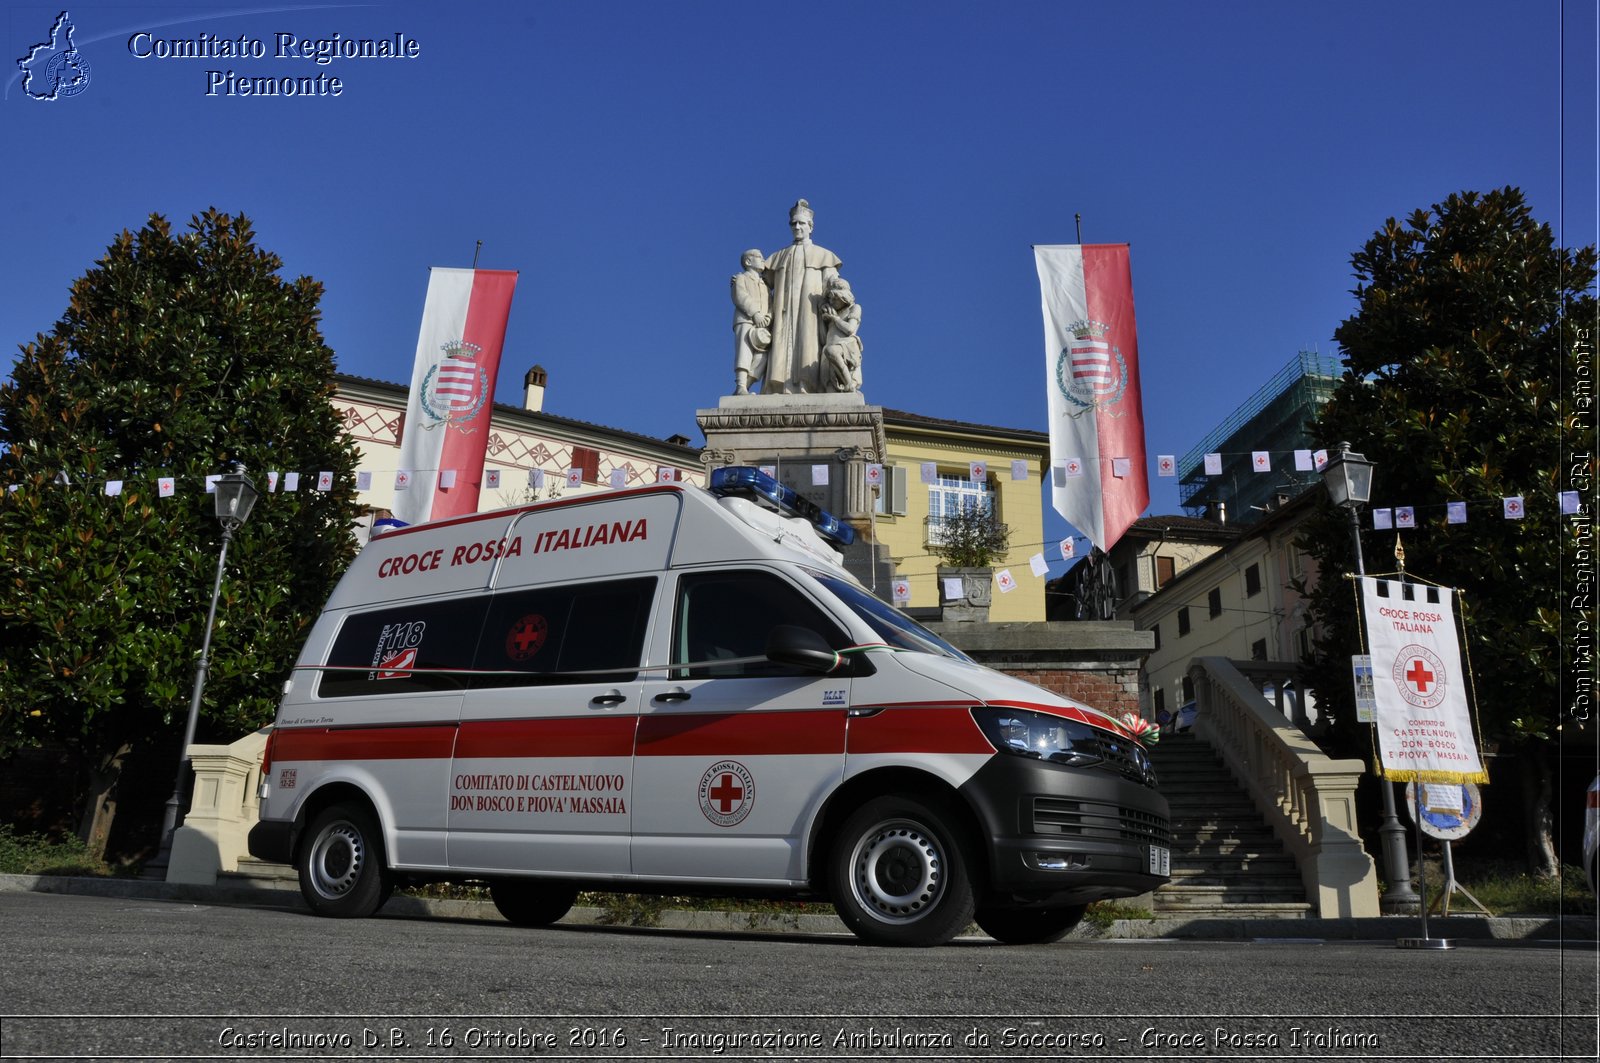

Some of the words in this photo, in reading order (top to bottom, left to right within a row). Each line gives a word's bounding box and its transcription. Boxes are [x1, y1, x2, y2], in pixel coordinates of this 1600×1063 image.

[378, 549, 444, 579] CROCE
[450, 536, 522, 567] ROSSA
[533, 518, 648, 555] ITALIANA
[1379, 607, 1409, 620] CROCE
[1413, 611, 1444, 623] ROSSA
[386, 620, 426, 650] 118
[1392, 621, 1434, 634] ITALIANA
[1408, 719, 1438, 727] COMITATO
[1402, 740, 1423, 748] DON
[1428, 740, 1456, 750] BOSCO
[1436, 751, 1469, 761] MASSAIA
[455, 774, 515, 791] COMITATO
[516, 774, 529, 791] DI
[531, 774, 624, 792] CASTELNUOVO
[701, 771, 712, 799] CROCE
[712, 763, 735, 774] ROSSA
[736, 765, 753, 800] ITALIANA
[451, 795, 475, 812] DON
[476, 796, 515, 812] BOSCO
[517, 796, 525, 812] E
[527, 797, 567, 813] PIOVA'
[569, 797, 627, 814] MASSAIA
